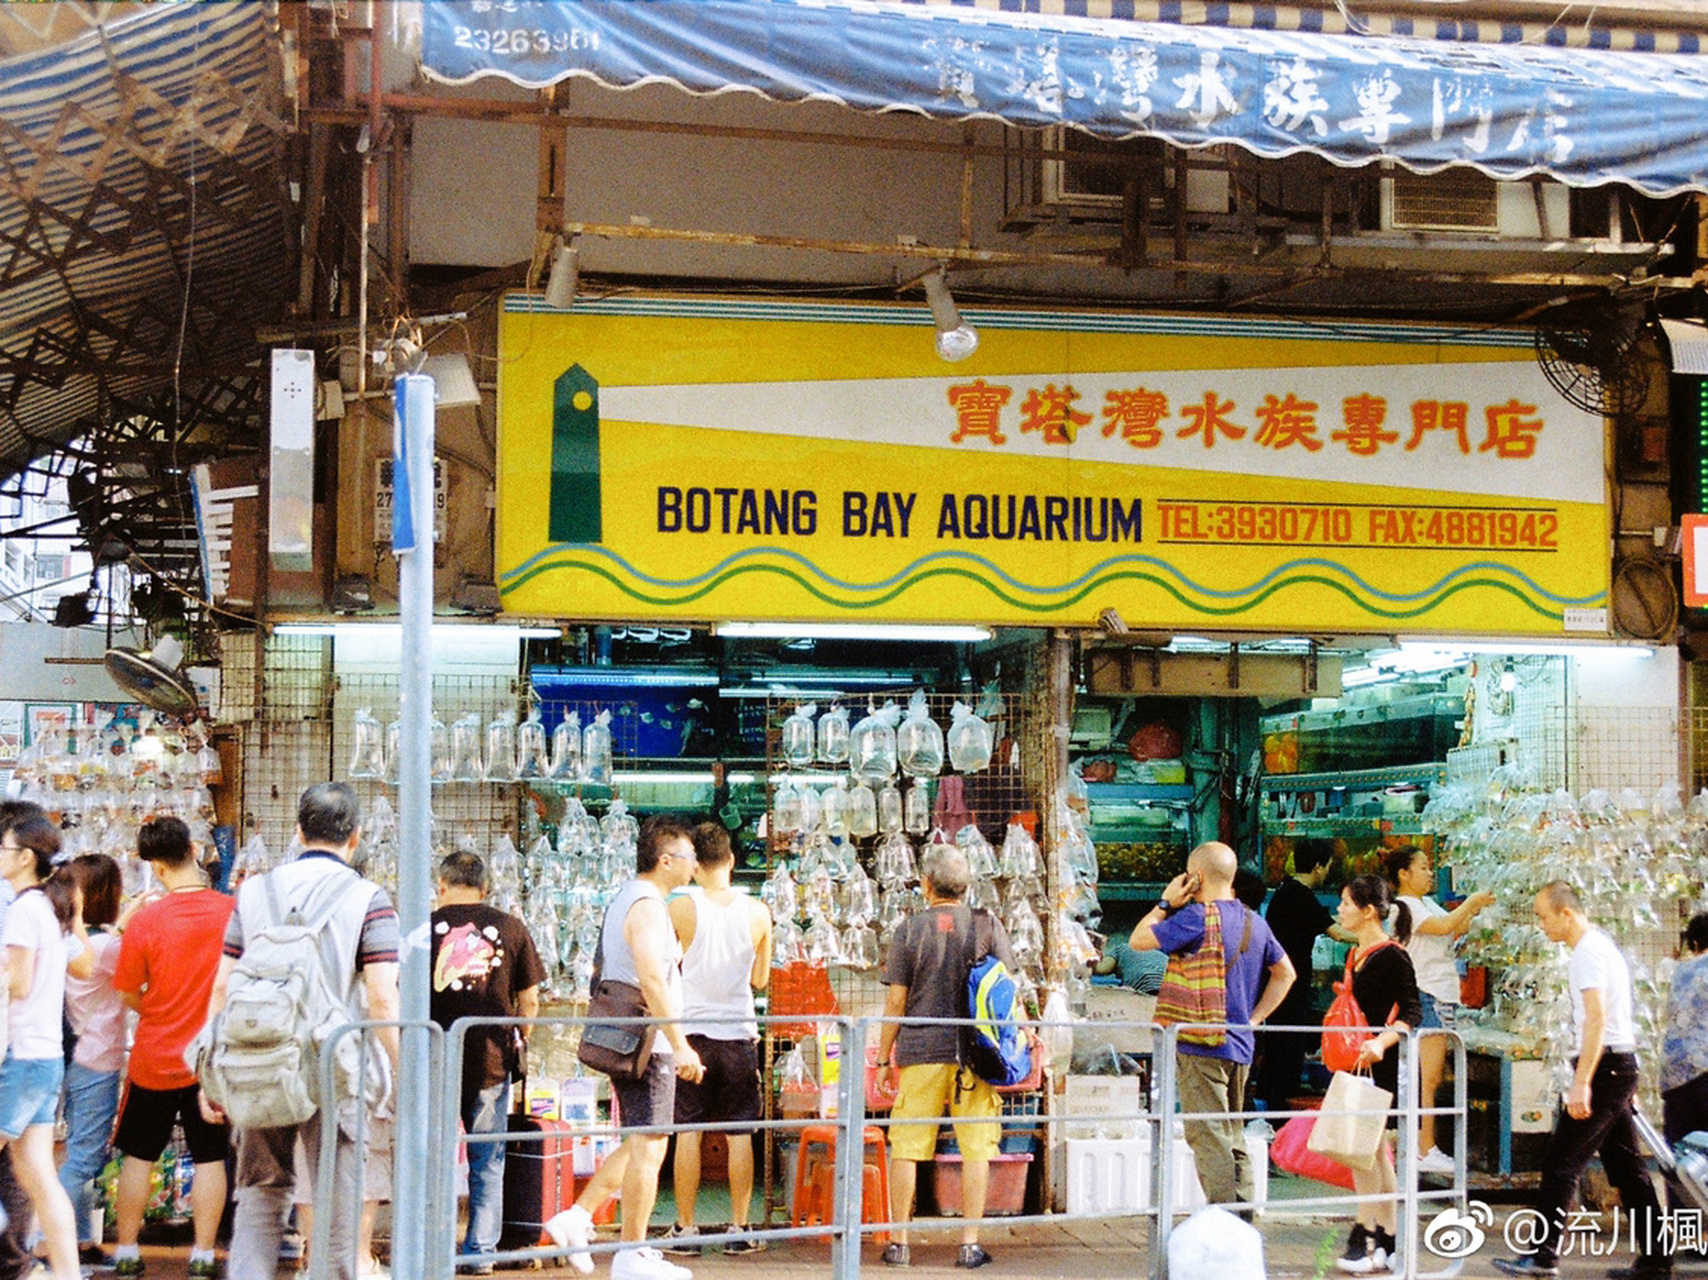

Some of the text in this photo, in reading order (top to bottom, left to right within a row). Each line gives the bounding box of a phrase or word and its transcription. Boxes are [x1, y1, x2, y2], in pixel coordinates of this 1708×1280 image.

[947, 378, 1543, 460] 寶塔灣水族專門店
[657, 486, 1558, 547] BOTANG BAY AQUARIUM TEL:3930710 FAX:4881942
